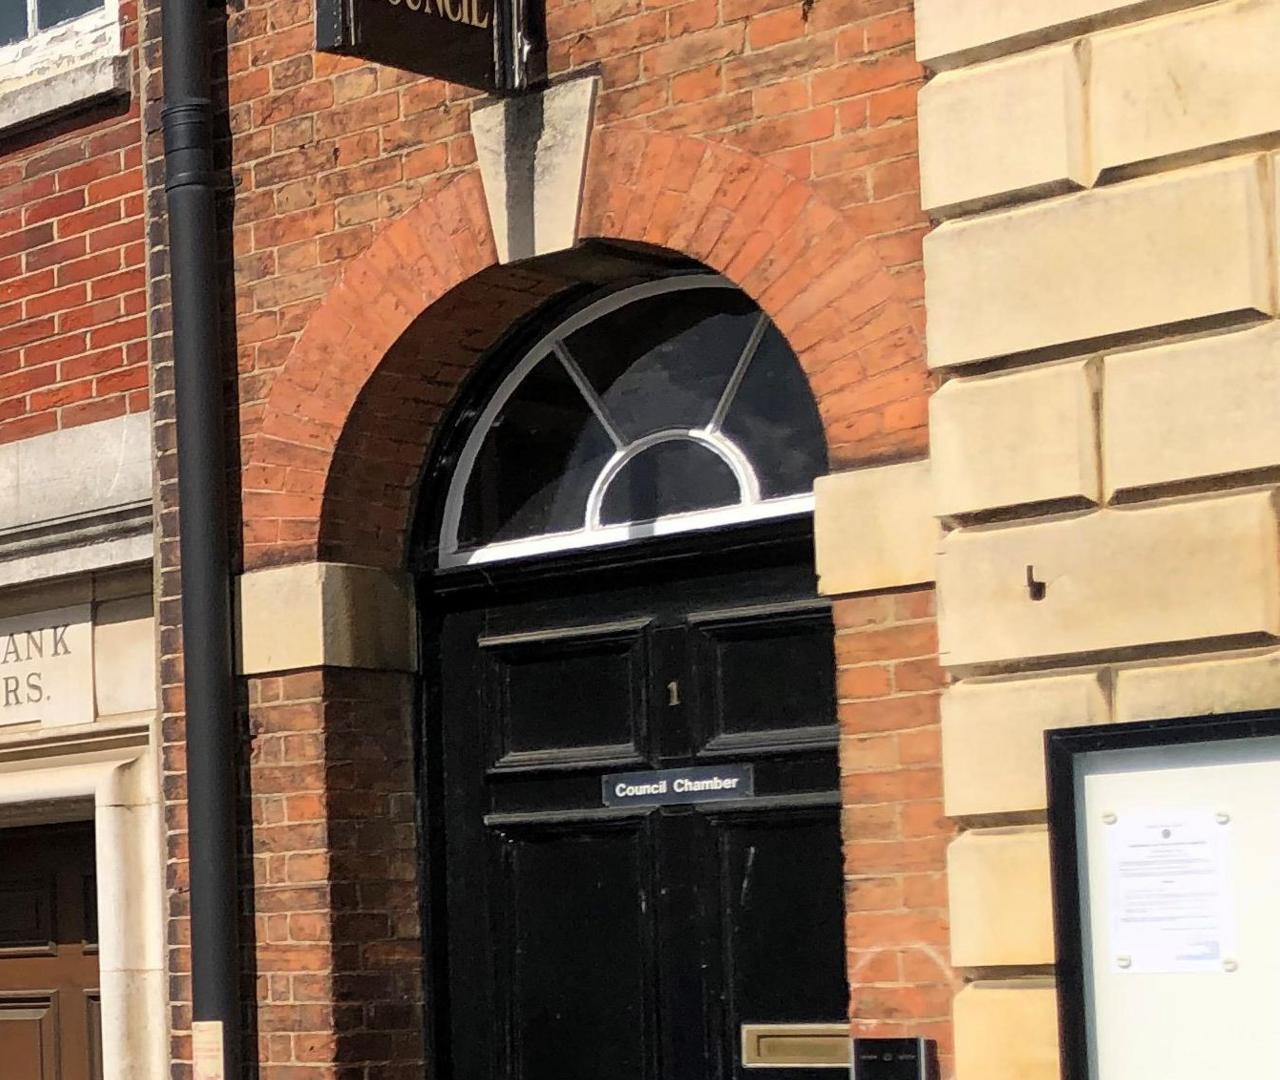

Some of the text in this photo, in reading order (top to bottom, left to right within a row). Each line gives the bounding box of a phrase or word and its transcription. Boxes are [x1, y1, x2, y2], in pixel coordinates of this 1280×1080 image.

[667, 681, 680, 706] 1
[615, 776, 739, 798] Council Chamber
